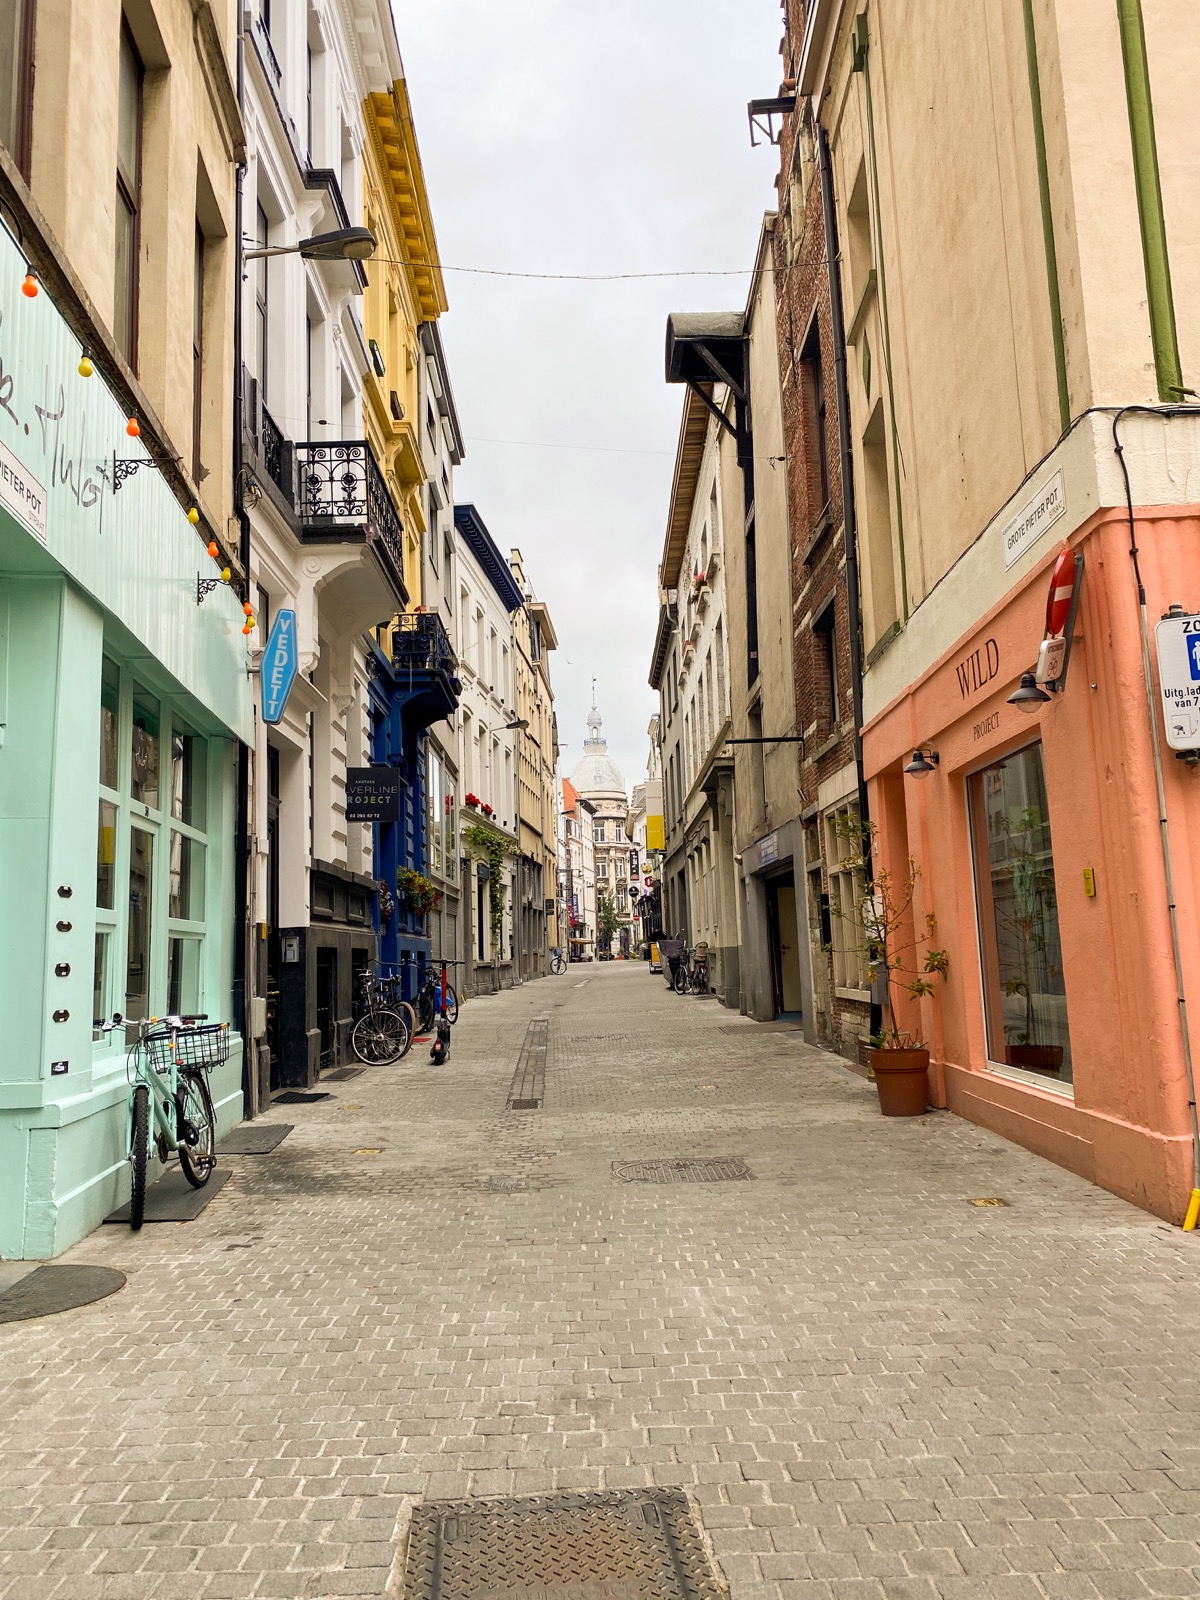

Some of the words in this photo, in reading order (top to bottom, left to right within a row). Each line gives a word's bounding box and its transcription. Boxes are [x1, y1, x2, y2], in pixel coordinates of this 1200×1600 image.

[0, 460, 25, 498] IETER
[26, 485, 42, 515] POT
[1007, 523, 1026, 550] GROTE
[1026, 502, 1046, 532] PIETER
[1046, 488, 1058, 511] POT
[268, 618, 291, 715] VEDETT
[955, 638, 1000, 701] WILD
[972, 711, 1000, 742] PROJECT
[1175, 698, 1191, 709] van
